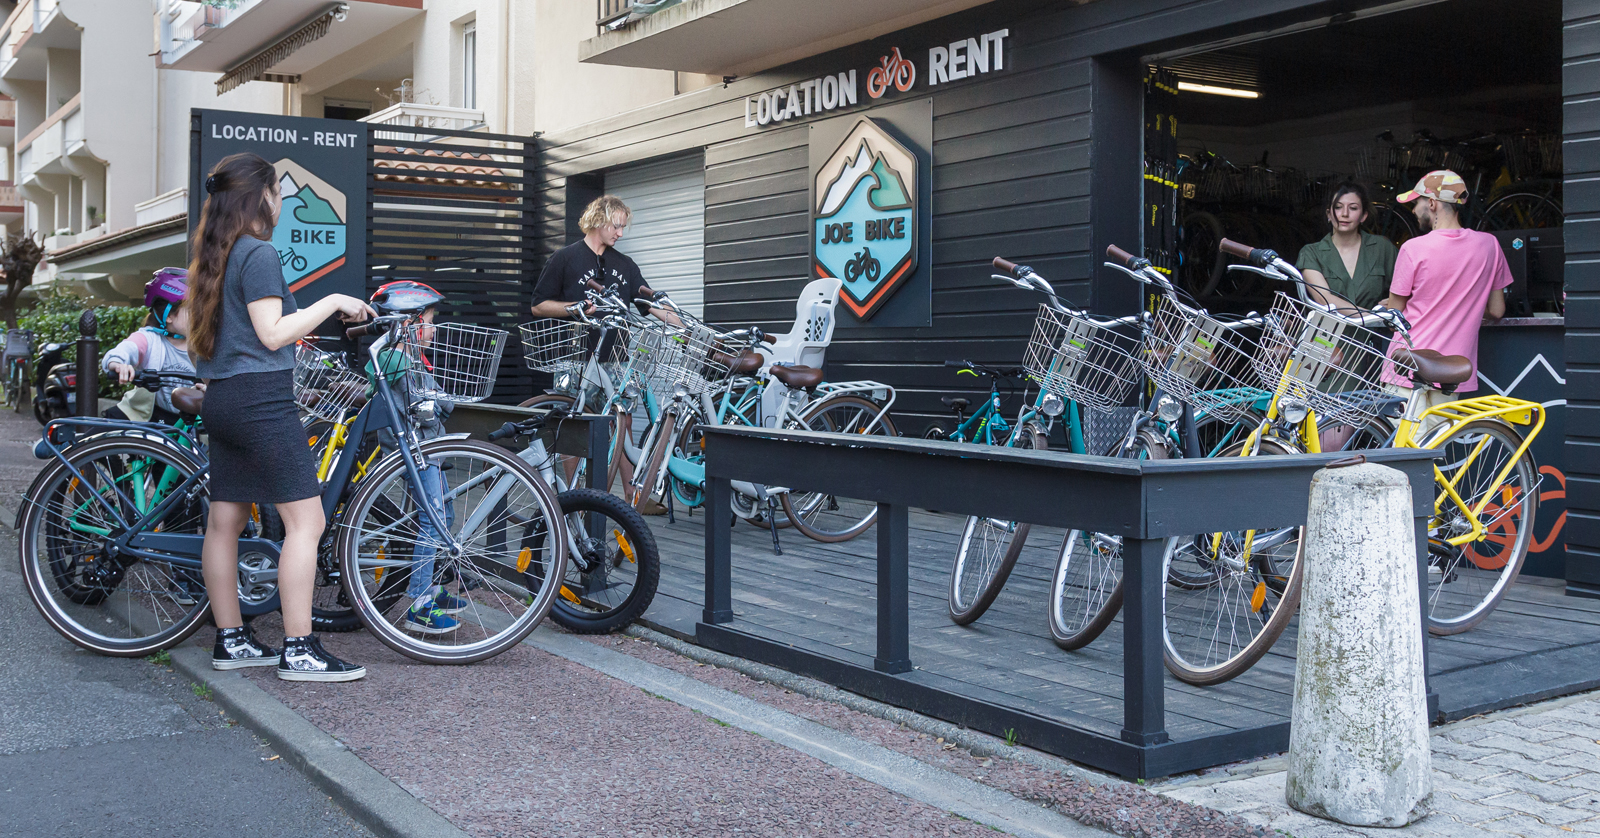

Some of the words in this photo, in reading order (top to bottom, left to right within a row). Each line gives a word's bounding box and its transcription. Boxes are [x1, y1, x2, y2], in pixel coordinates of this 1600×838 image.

[745, 69, 857, 128] LOCATION
[928, 28, 1009, 85] RENT
[212, 123, 297, 144] LOCATION
[313, 131, 358, 148] RENT
[290, 228, 336, 245] BIKE
[821, 221, 854, 245] JOE
[865, 216, 906, 242] BIKE
[612, 269, 628, 286] BAY
